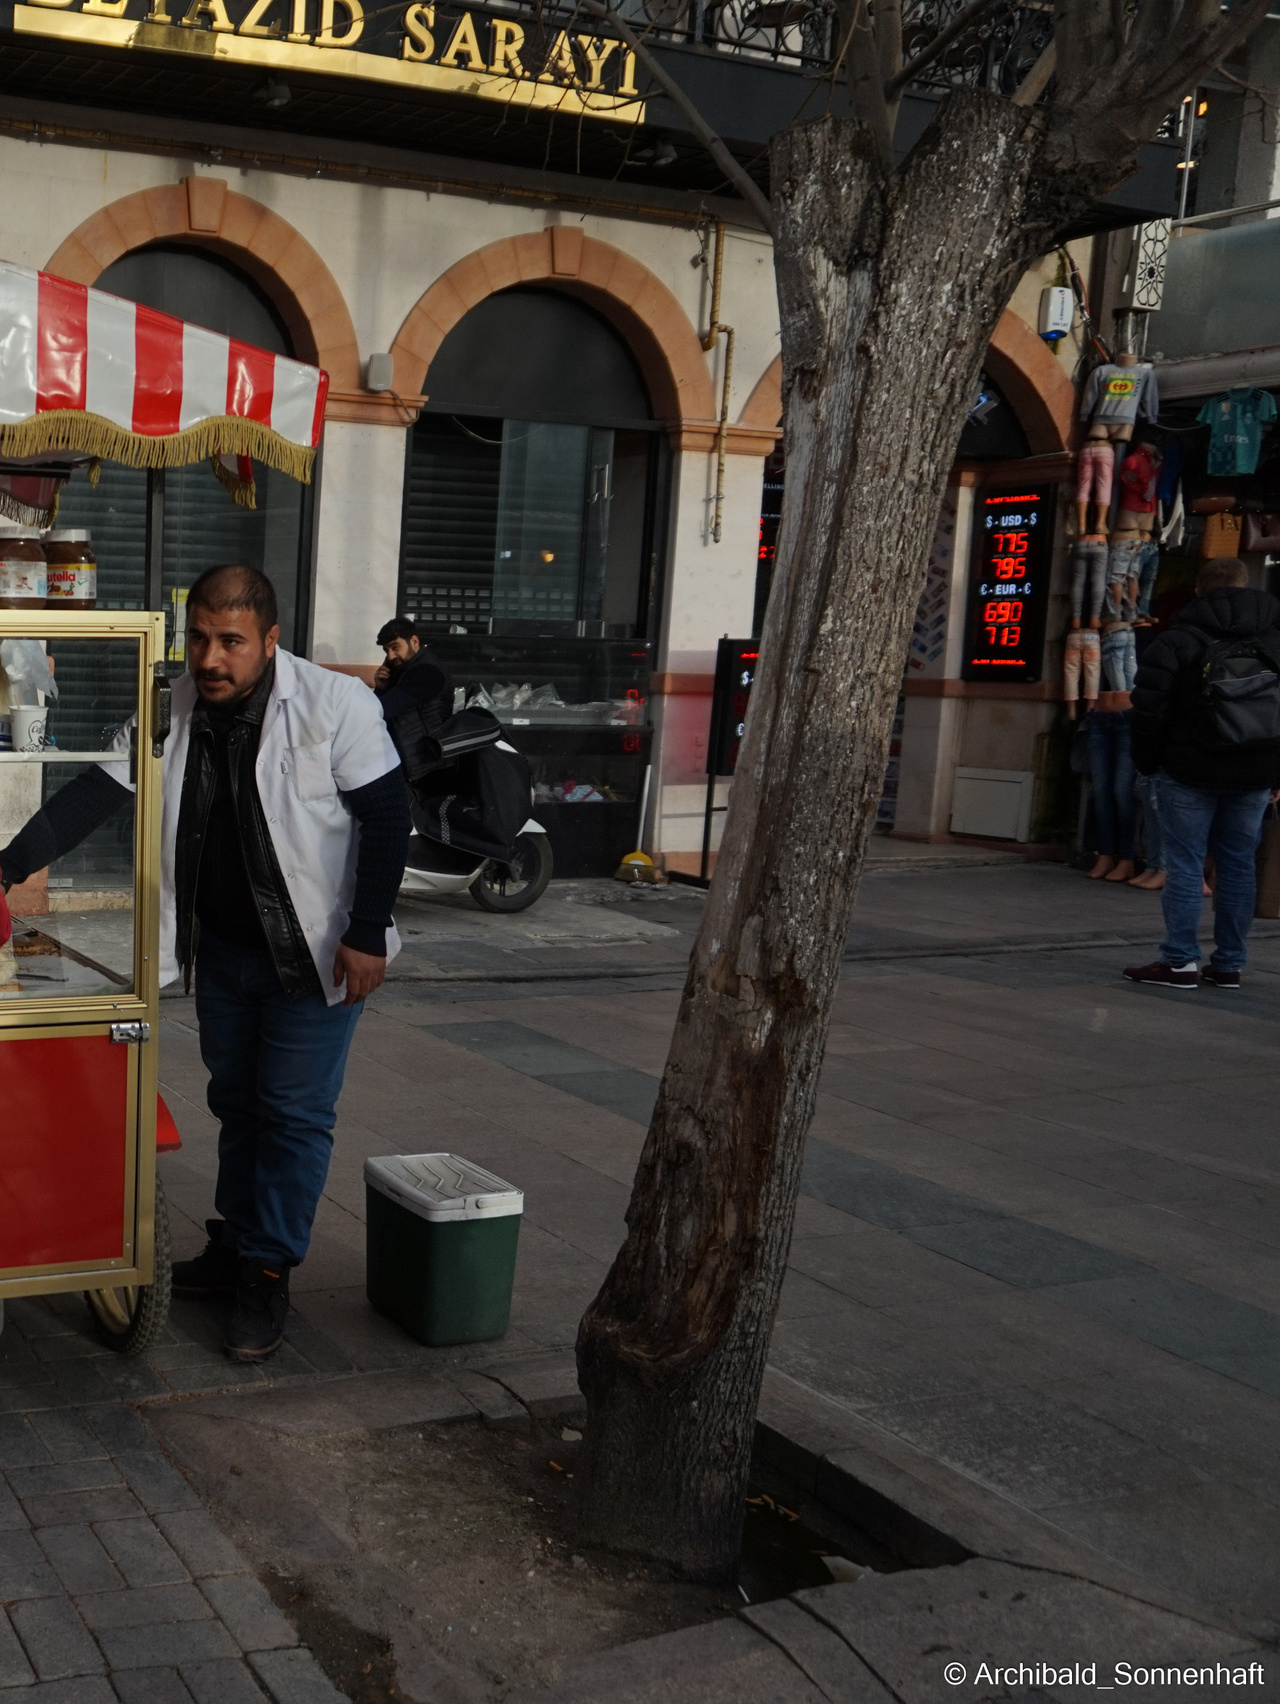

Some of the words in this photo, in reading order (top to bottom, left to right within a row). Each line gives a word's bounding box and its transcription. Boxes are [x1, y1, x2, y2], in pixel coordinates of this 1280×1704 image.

[1001, 514, 1022, 527] USD
[992, 531, 1029, 553] 775
[47, 571, 76, 582] utella
[990, 556, 1027, 579] 795
[995, 583, 1017, 595] EUR
[983, 601, 1024, 623] 690
[983, 625, 1021, 647] 713
